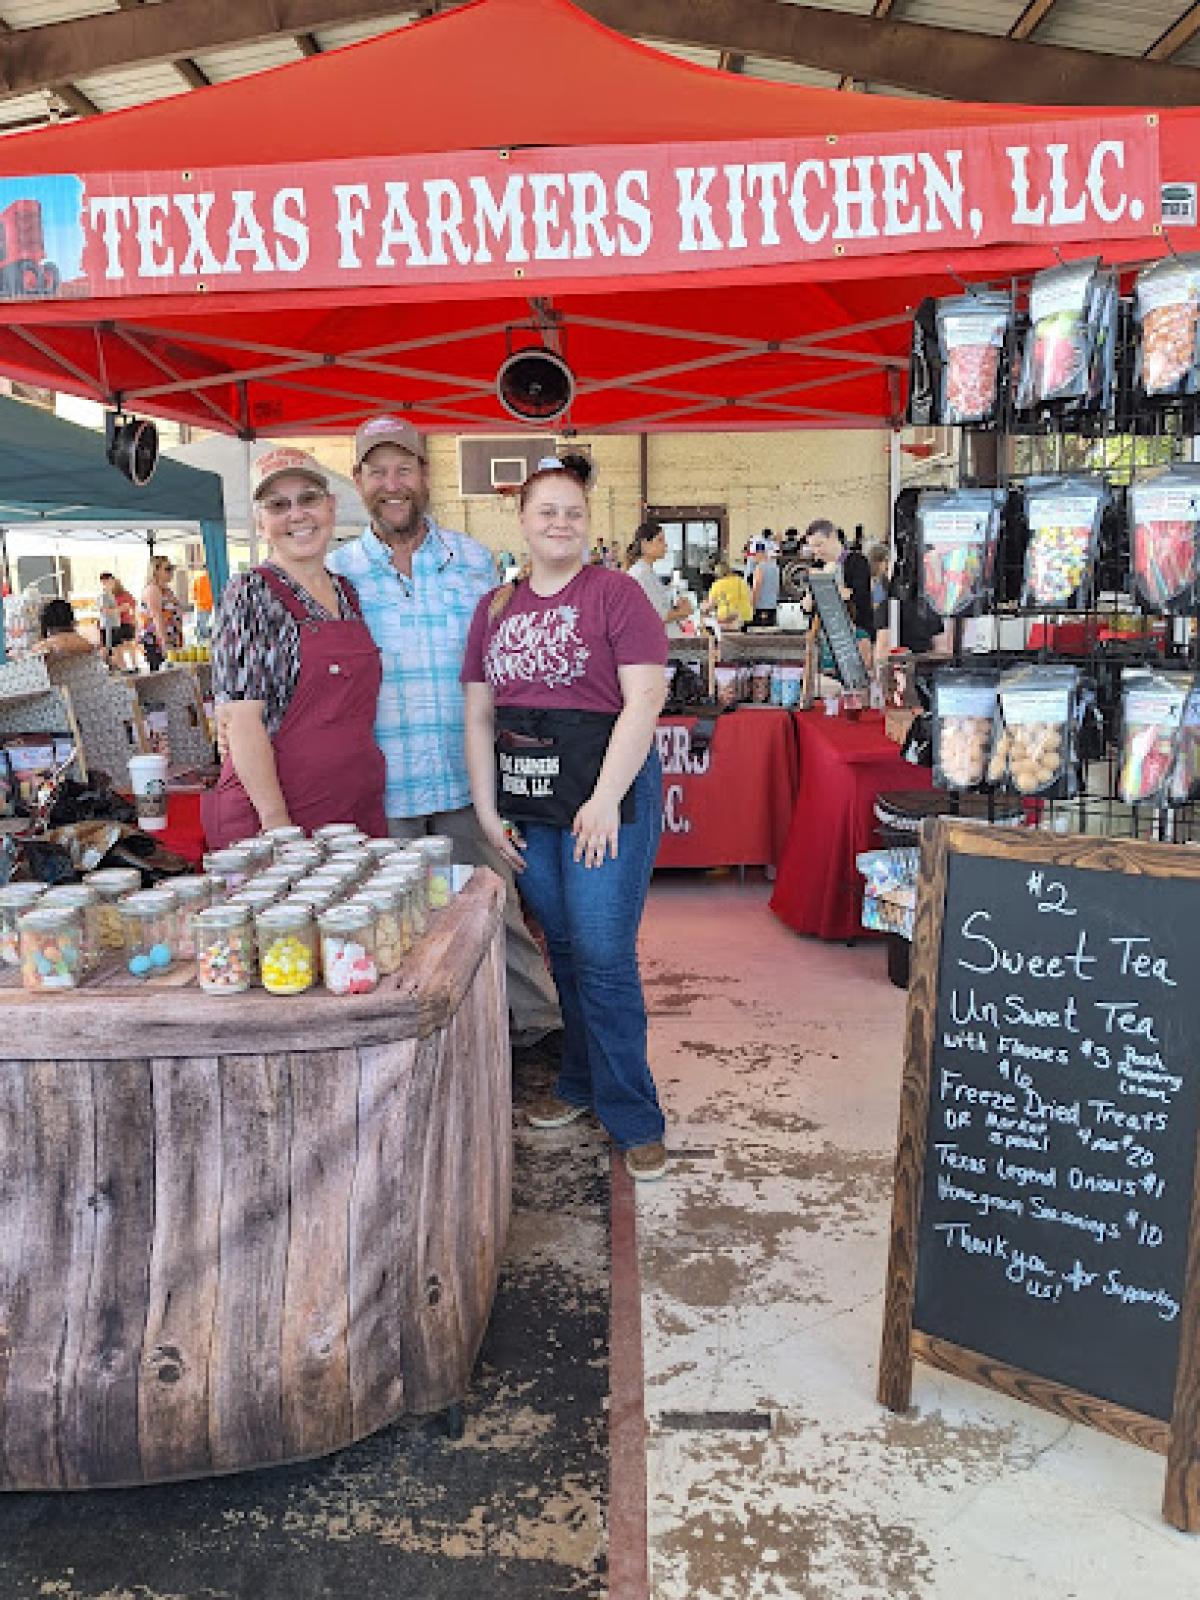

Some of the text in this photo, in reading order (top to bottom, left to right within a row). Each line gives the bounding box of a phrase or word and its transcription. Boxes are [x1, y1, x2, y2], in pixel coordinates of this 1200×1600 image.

[88, 140, 1145, 281] TEXAS FARMERS KITCHEN, LLC.
[958, 911, 1178, 986] Sweet Tea
[1093, 1002, 1160, 1044] Tea
[941, 1066, 1169, 1132] Freeze Dried Treats
[934, 1143, 987, 1174] Texas
[1067, 1166, 1137, 1198] Onions
[932, 1222, 1010, 1260] Thank
